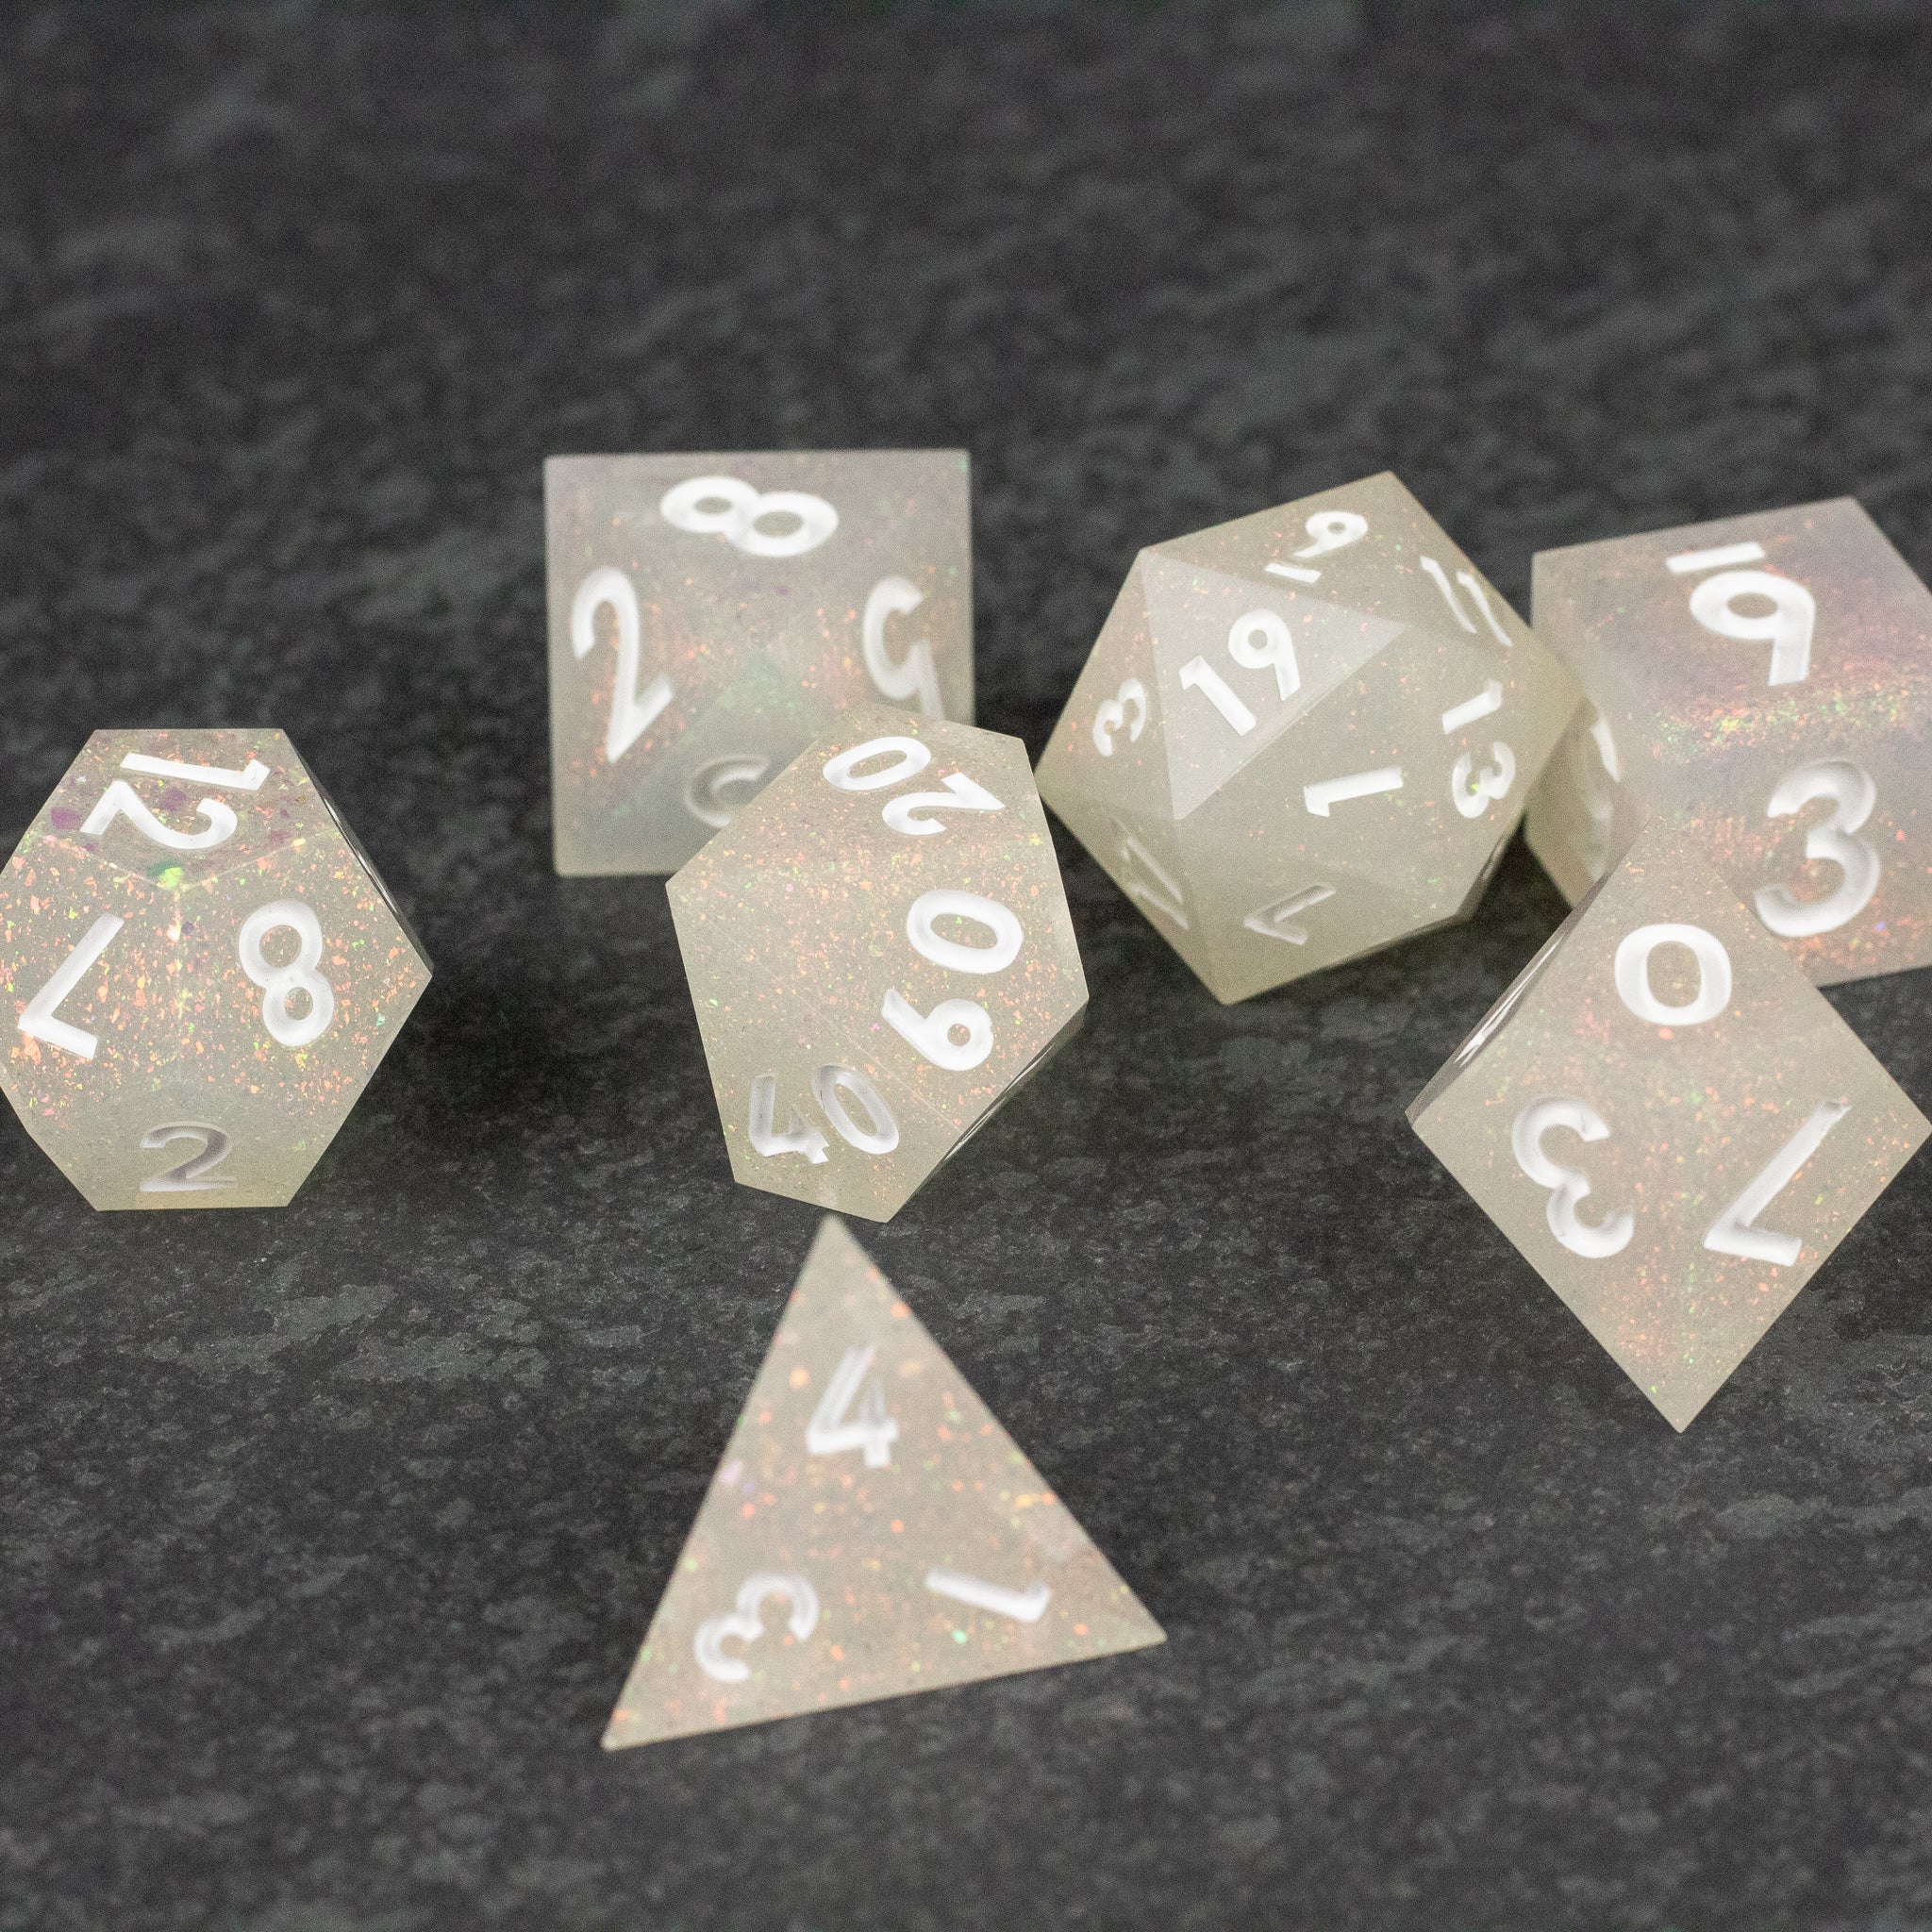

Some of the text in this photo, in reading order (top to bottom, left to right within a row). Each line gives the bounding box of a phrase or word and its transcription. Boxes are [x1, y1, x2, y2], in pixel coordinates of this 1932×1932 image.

[660, 475, 839, 557] 8
[1421, 556, 1513, 646] 11
[572, 567, 674, 764] 2
[1092, 678, 1146, 757] 3
[1178, 608, 1302, 736] 19
[79, 753, 271, 850] 12
[823, 736, 1006, 836] 20
[1303, 767, 1404, 818] 1
[1441, 678, 1517, 819] 13
[1754, 758, 1881, 938] 3
[1243, 883, 1337, 945] 7
[17, 911, 125, 1060] 7
[238, 898, 336, 1048] 8
[881, 888, 1024, 1072] 60
[1614, 923, 1733, 1026] 0
[139, 1121, 239, 1192] 2
[748, 1064, 900, 1164] 40
[1511, 1096, 1634, 1258] 3
[1702, 1100, 1853, 1267] 7
[806, 1343, 899, 1468] 4
[693, 1573, 820, 1683] 3
[925, 1569, 1051, 1623] 1
